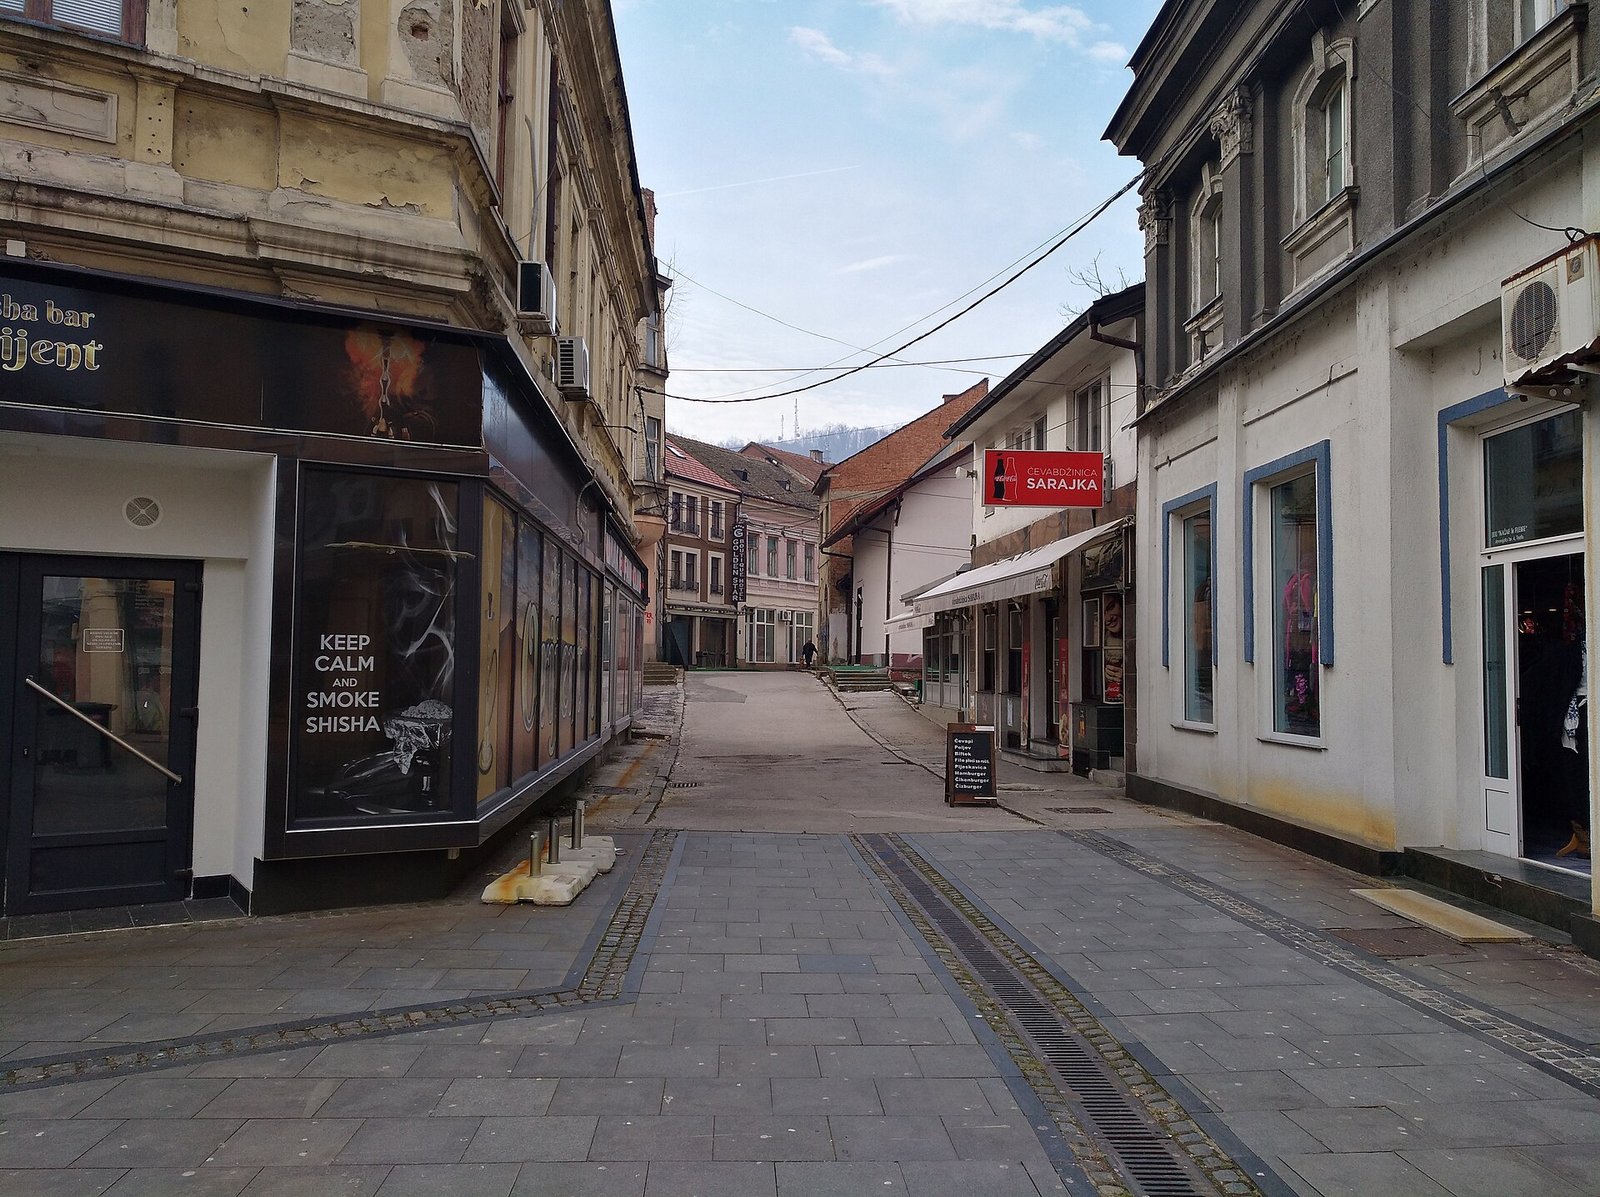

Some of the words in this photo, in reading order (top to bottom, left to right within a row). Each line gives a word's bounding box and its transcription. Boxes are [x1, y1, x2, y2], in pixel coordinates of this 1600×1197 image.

[0, 293, 39, 321] ha
[45, 299, 96, 329] bar
[1027, 477, 1098, 491] SARAJKA
[320, 634, 371, 650] KEEP
[314, 655, 374, 672] CALM
[332, 678, 358, 687] AND
[306, 691, 380, 708] SMOKE
[306, 715, 380, 733] SHISHA
